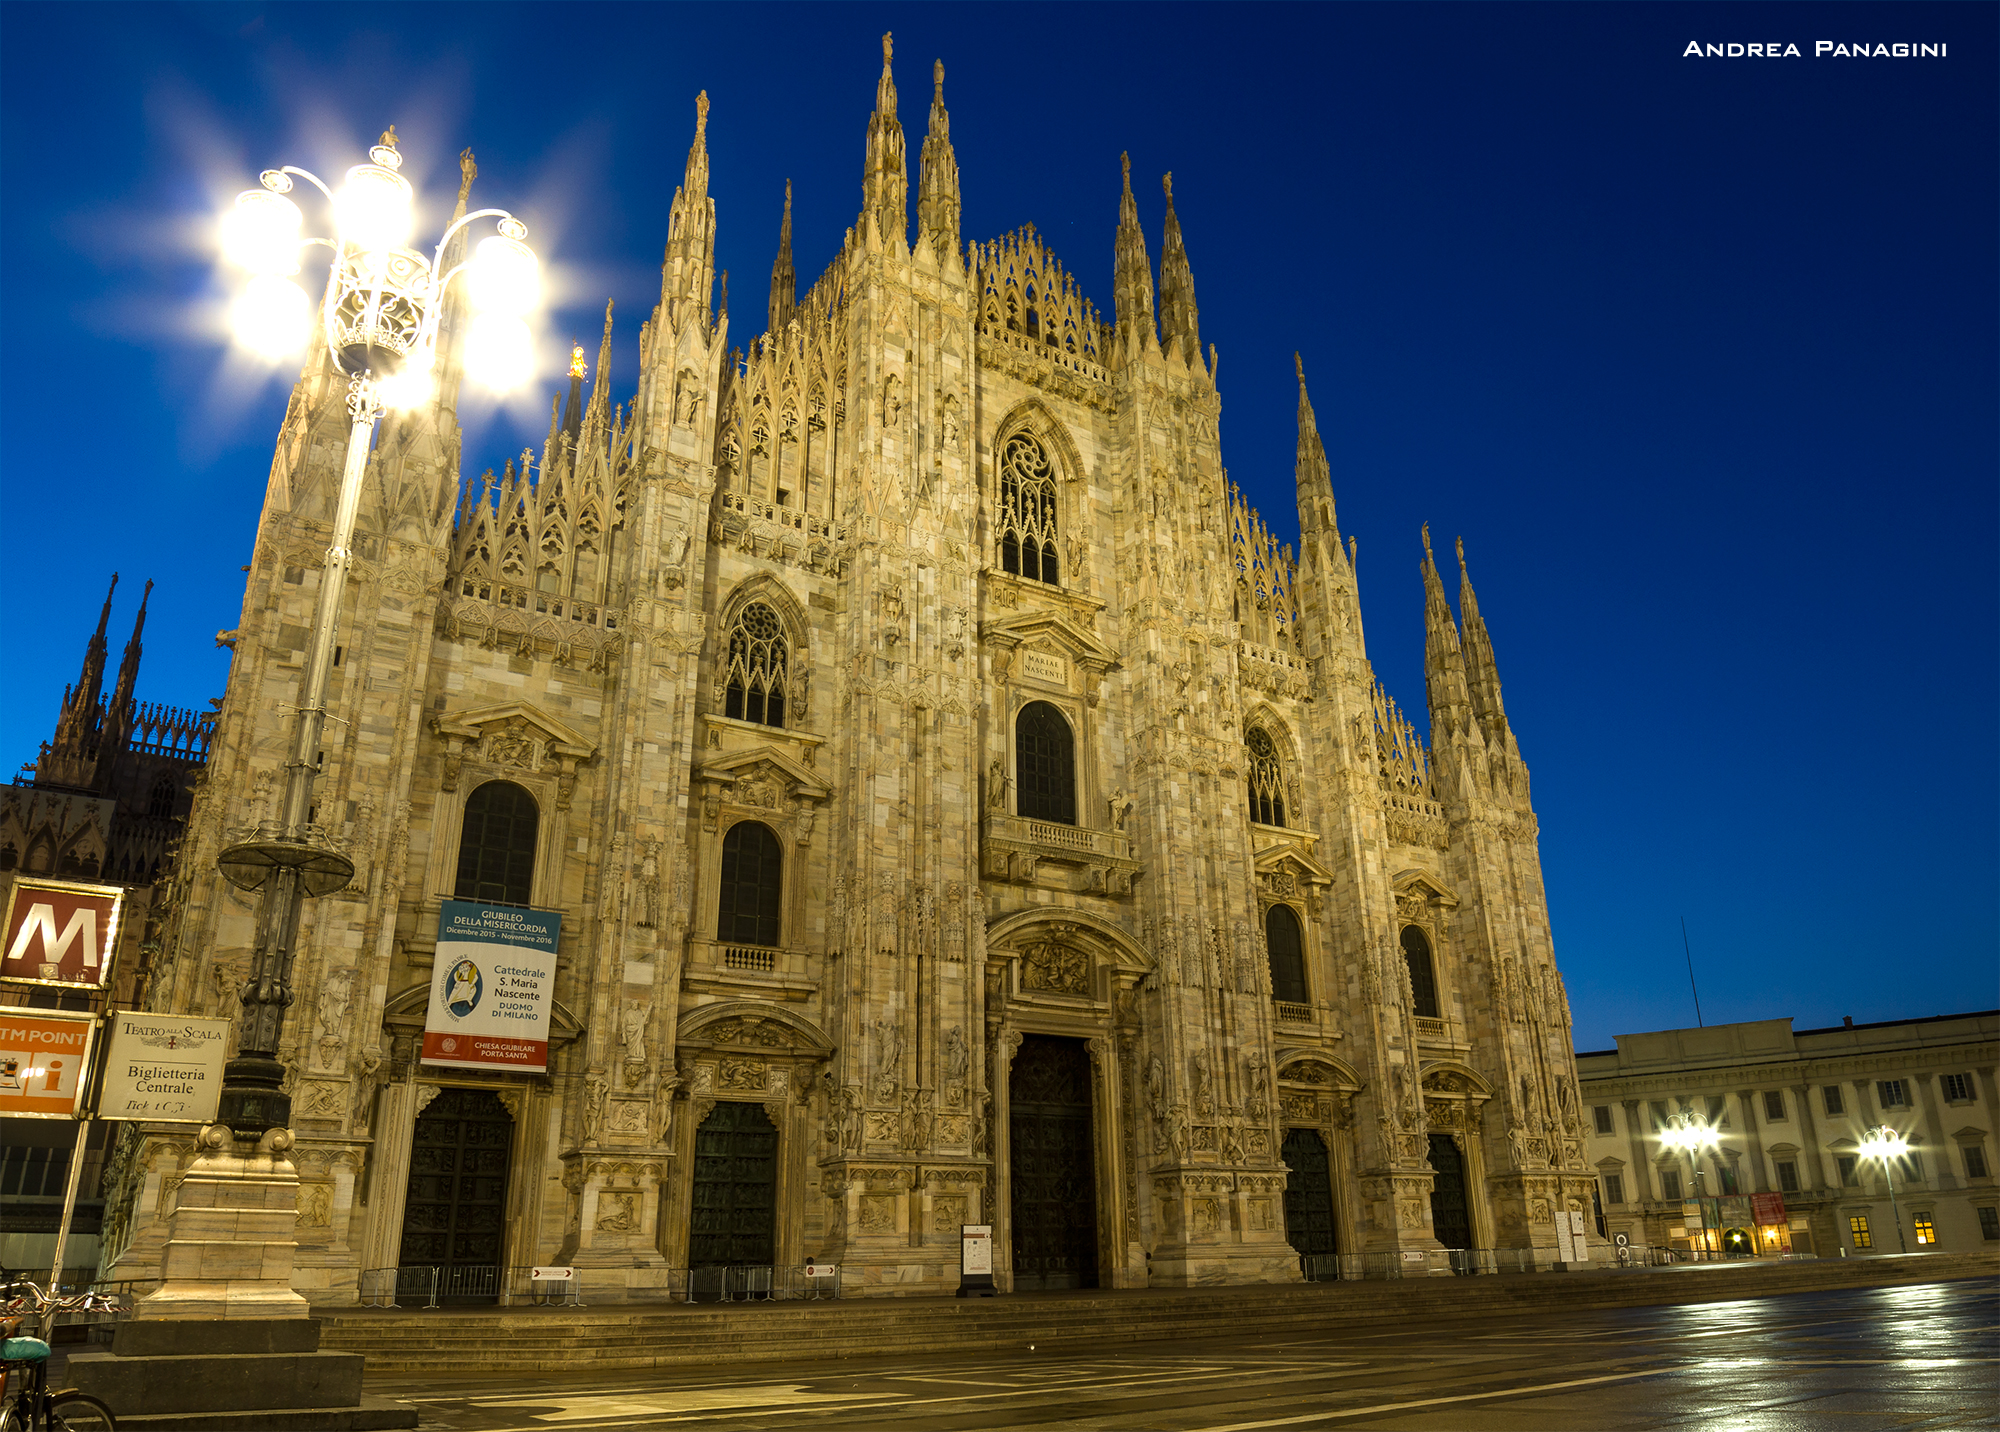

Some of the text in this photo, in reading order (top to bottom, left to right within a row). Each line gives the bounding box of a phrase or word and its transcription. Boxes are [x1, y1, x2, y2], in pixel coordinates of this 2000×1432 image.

[1028, 655, 1058, 668] MARIAE
[1024, 664, 1063, 680] NASCENTI
[482, 910, 523, 922] GIUBILEO
[454, 916, 547, 934] DELLA MISERICORDIA
[7, 902, 98, 967] M
[446, 926, 478, 936] Dicembre
[480, 930, 496, 938] 2015
[501, 933, 535, 942] Novembre
[536, 937, 552, 945] 2016
[494, 965, 545, 978] Cattedrale
[499, 977, 538, 989] S. Maria
[494, 988, 540, 1000] Nascente
[499, 1002, 533, 1011] DUOMO
[504, 1011, 538, 1020] MILANO
[123, 1022, 165, 1036] TEATRO
[183, 1026, 222, 1039] SCALA
[28, 1030, 86, 1045] POINT
[474, 1042, 536, 1052] CHIESA GIUBILARE
[481, 1050, 504, 1058] PORTA
[128, 1066, 205, 1080] Biglietteria
[136, 1080, 194, 1094] Centrale
